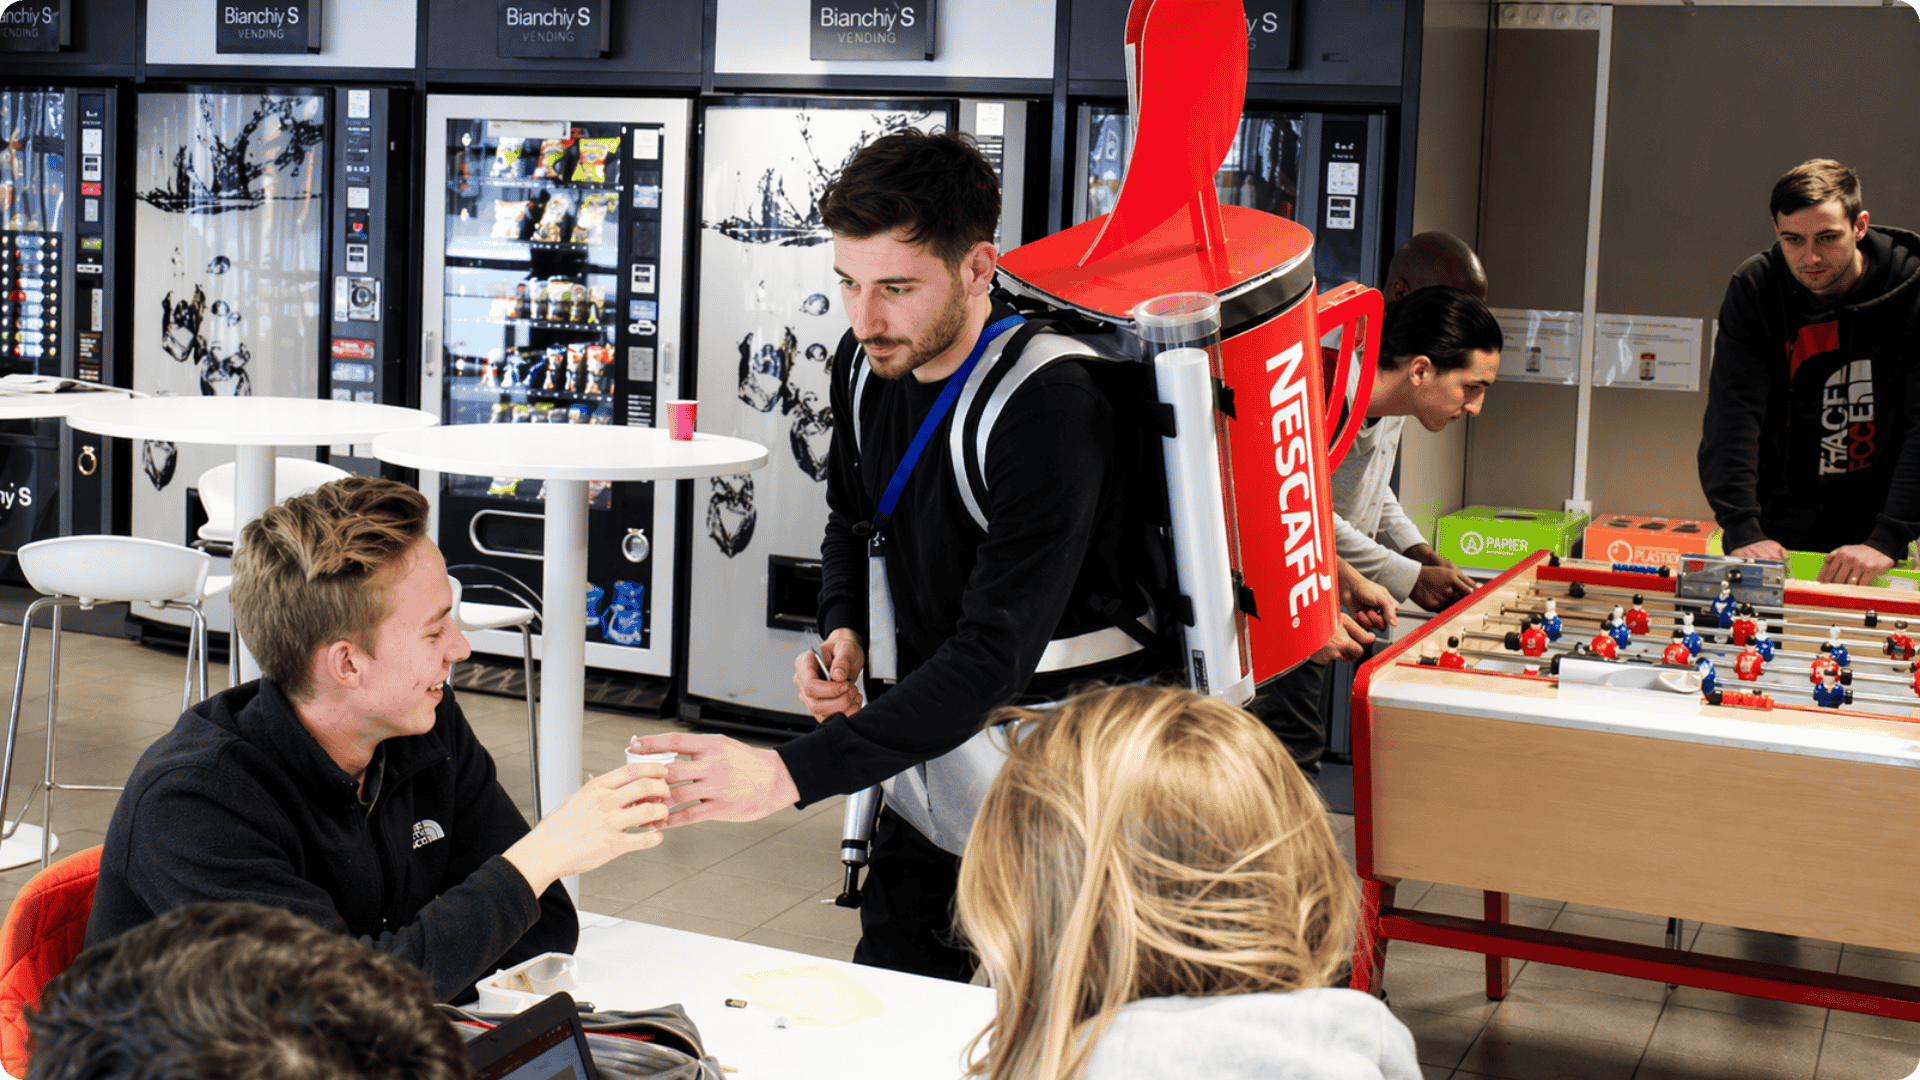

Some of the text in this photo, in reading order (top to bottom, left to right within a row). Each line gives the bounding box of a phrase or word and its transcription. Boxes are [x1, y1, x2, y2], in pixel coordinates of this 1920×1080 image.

[0, 7, 40, 27] anchiy
[238, 28, 284, 39] VENDING
[522, 31, 575, 42] VENDING
[838, 32, 897, 43] VENDING
[1486, 536, 1528, 552] PAPIER
